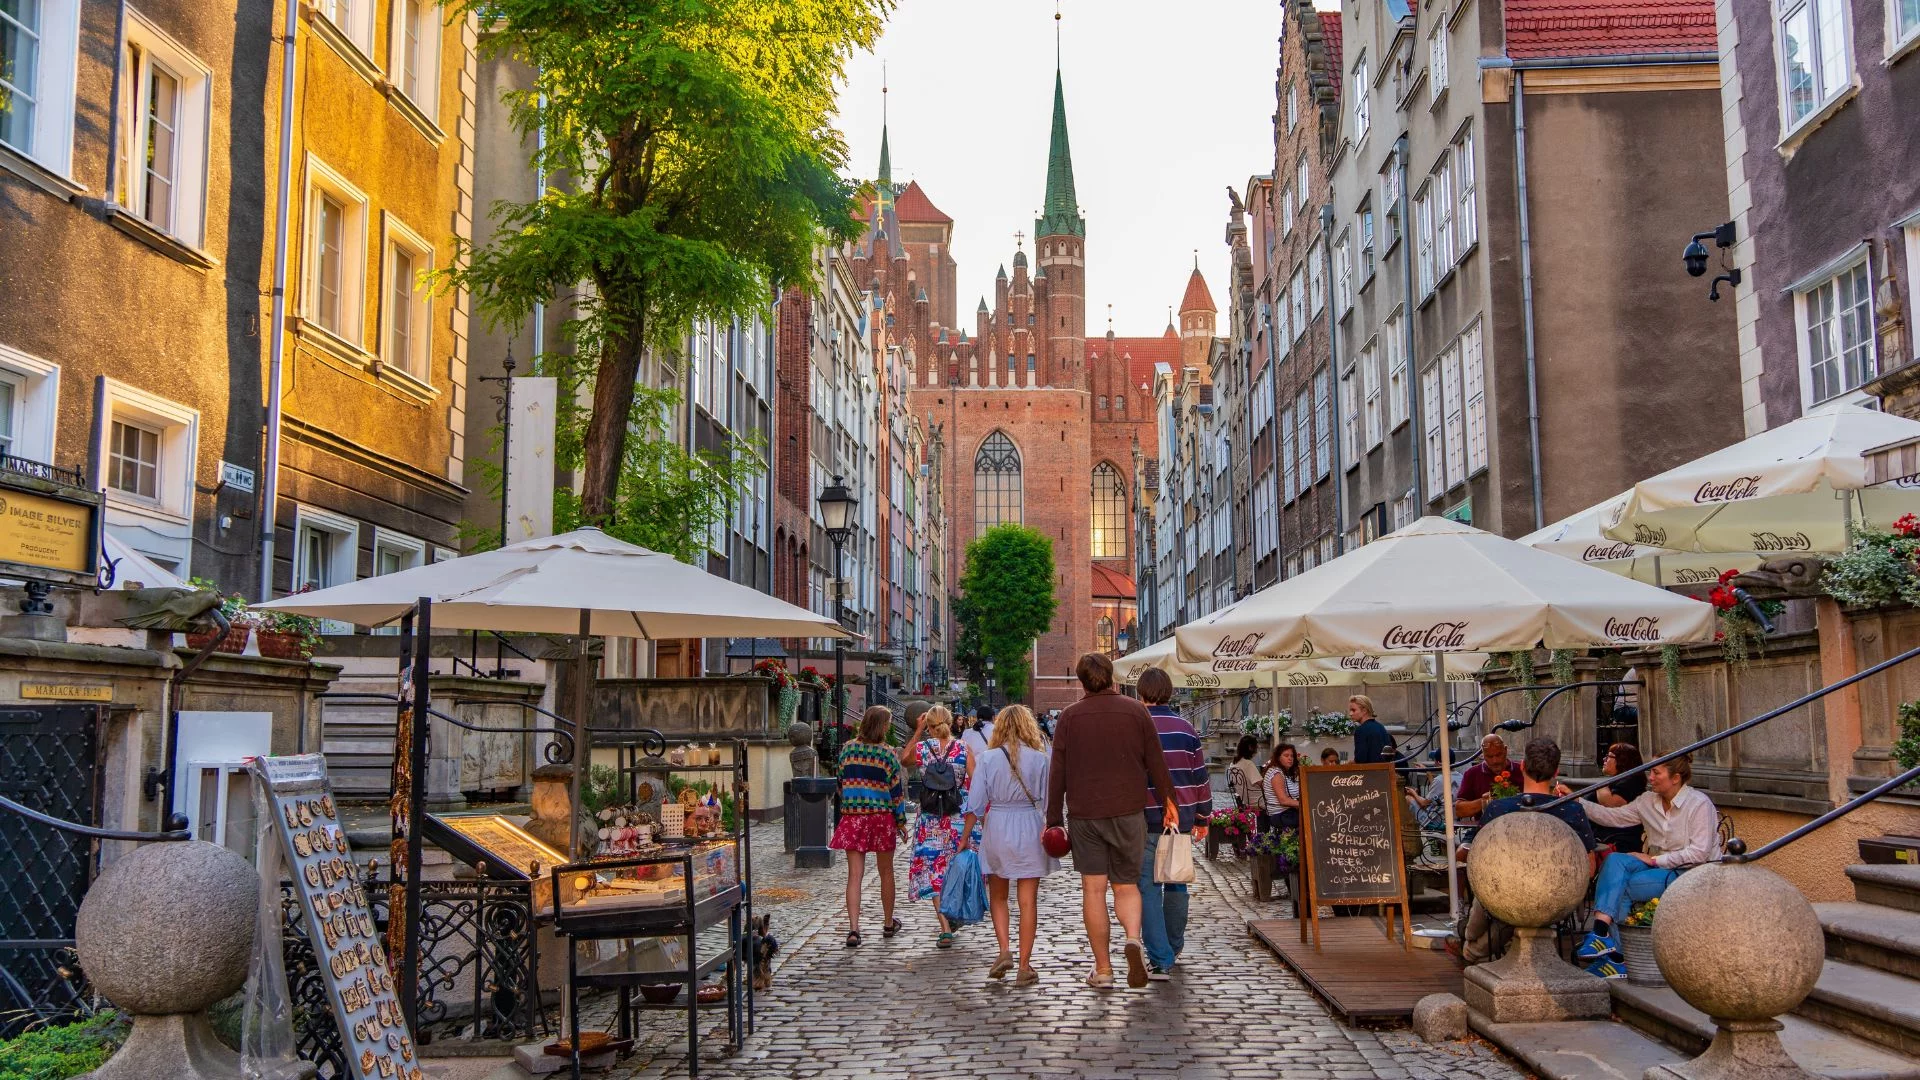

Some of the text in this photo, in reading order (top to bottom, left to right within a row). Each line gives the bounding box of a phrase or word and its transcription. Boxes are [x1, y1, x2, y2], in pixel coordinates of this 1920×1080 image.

[6, 456, 75, 484] IMAGE SILVER
[1694, 475, 1762, 503] Coca-Cola
[10, 506, 44, 521] IMAGE
[46, 514, 81, 528] SILVER
[20, 543, 58, 555] PRODUCENT
[1383, 621, 1470, 650] Coca-Cola
[1604, 617, 1661, 642] Coca-Cola
[35, 685, 79, 696] MARIACKA
[1331, 775, 1364, 787] Coca-Cola
[1361, 873, 1392, 883] LIBRE
